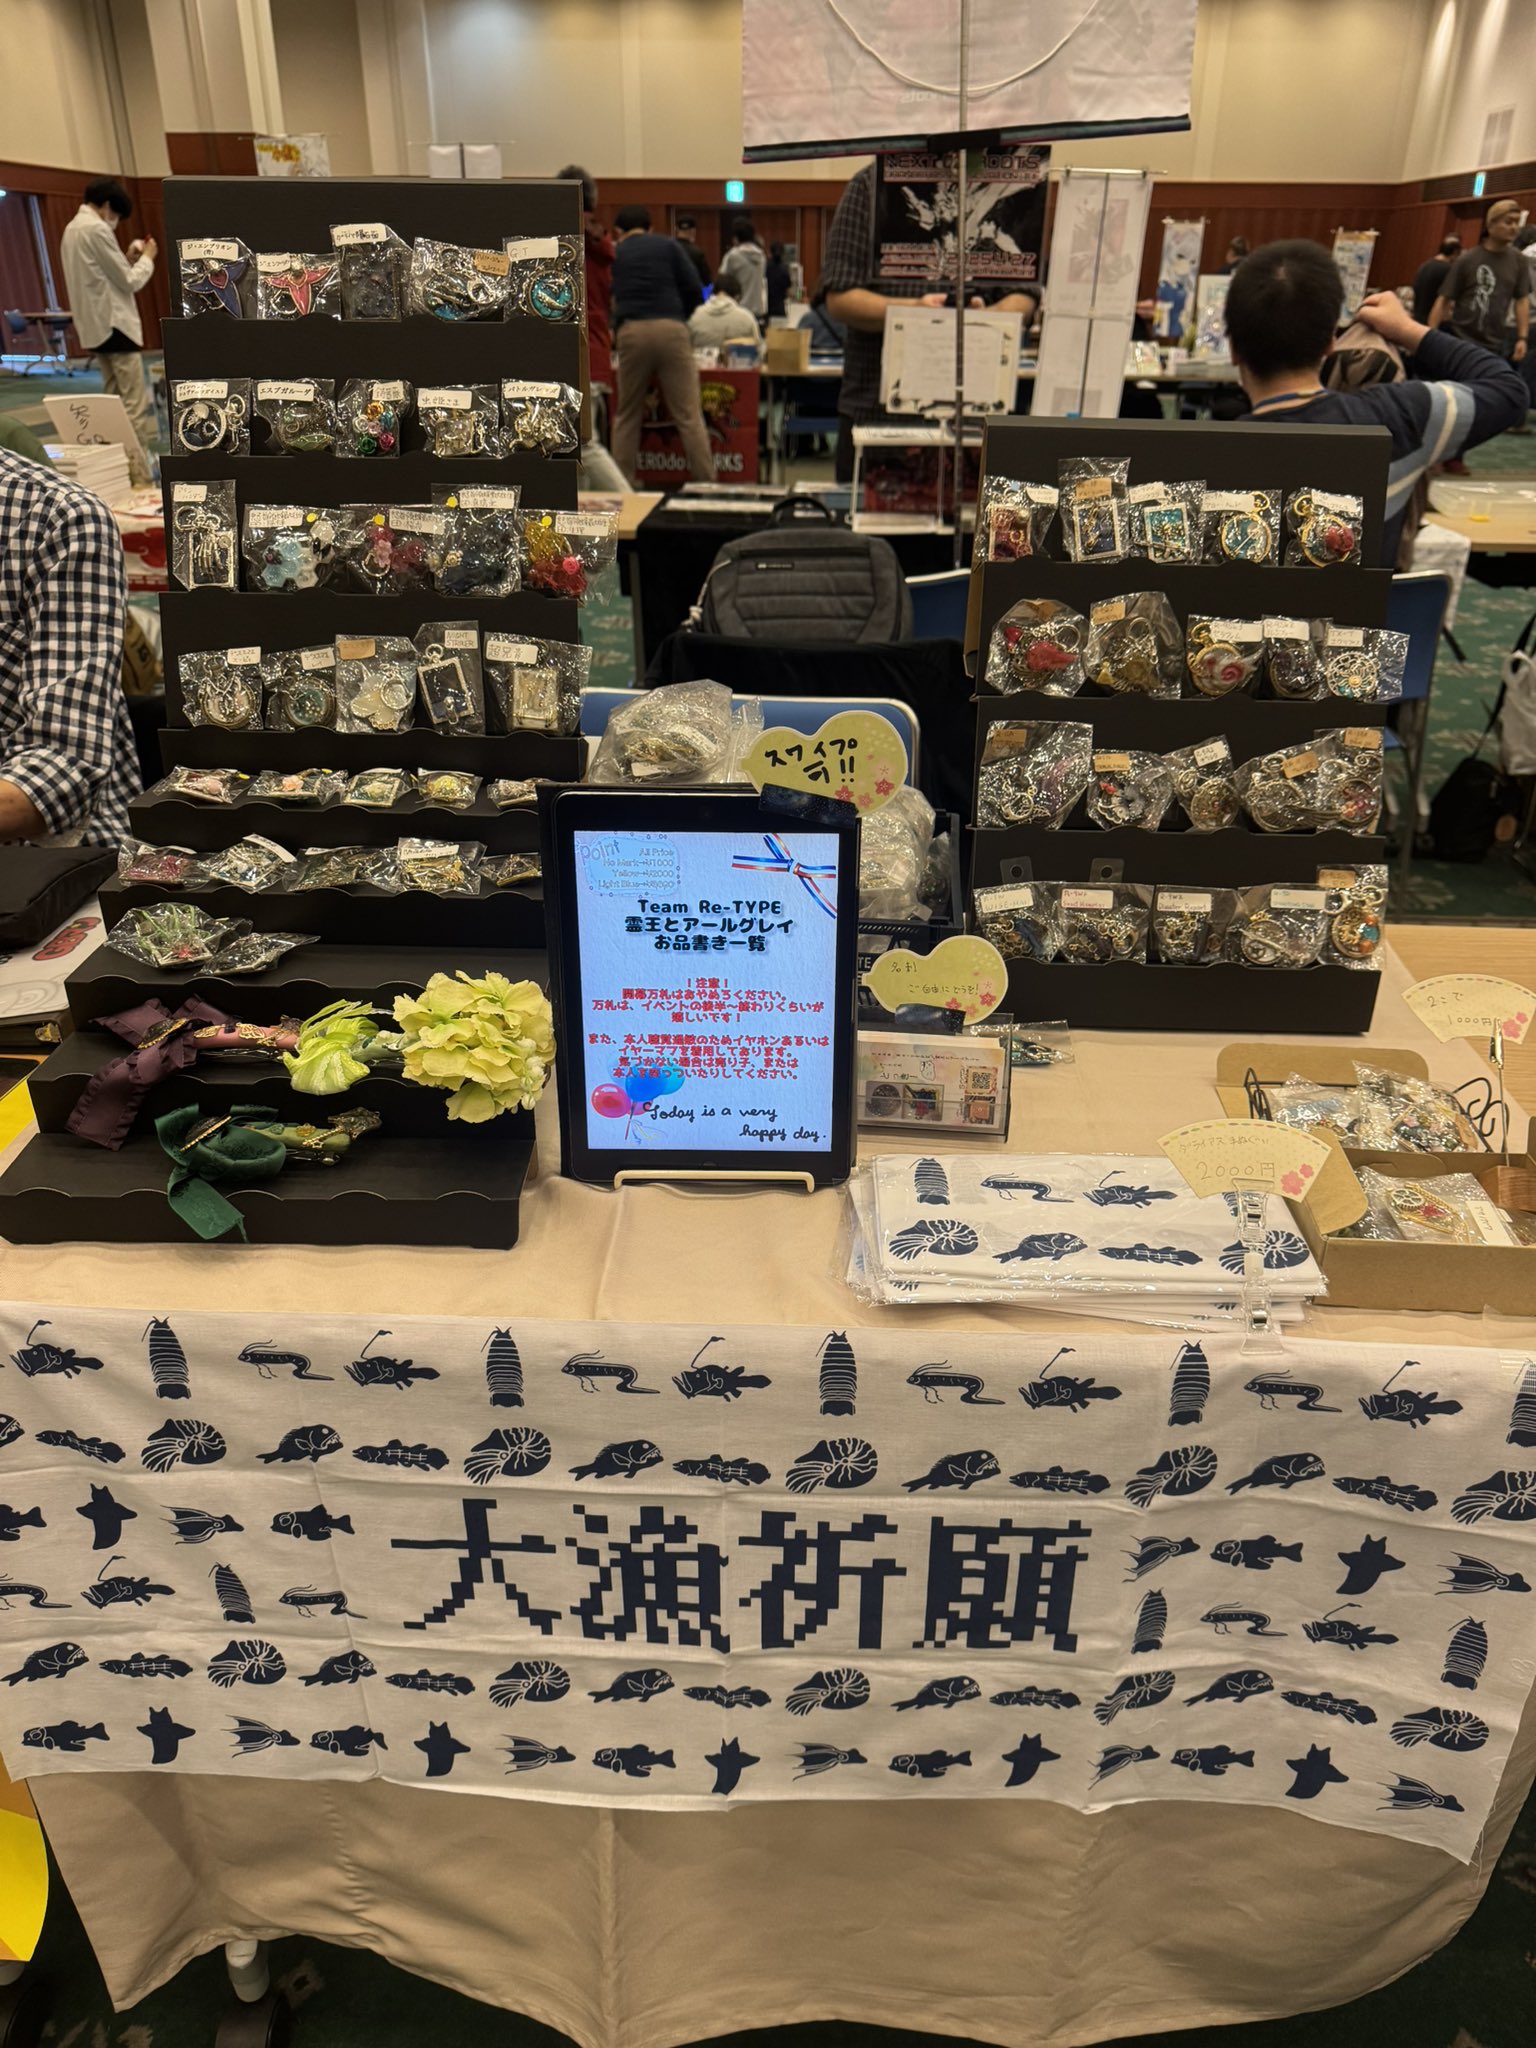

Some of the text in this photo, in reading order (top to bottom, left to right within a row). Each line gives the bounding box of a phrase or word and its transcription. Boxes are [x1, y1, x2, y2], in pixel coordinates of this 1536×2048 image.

[764, 738, 858, 768] スワイプ
[638, 900, 782, 914] Team Re-TYPE
[624, 916, 794, 934] 霊王とアールグレイ
[654, 934, 766, 952] お品書き一覧
[643, 1101, 778, 1124] Today is a very
[739, 1124, 787, 1143] happy
[1195, 1160, 1276, 1181] 2000円
[390, 1497, 1089, 1653] 大漁祈願
